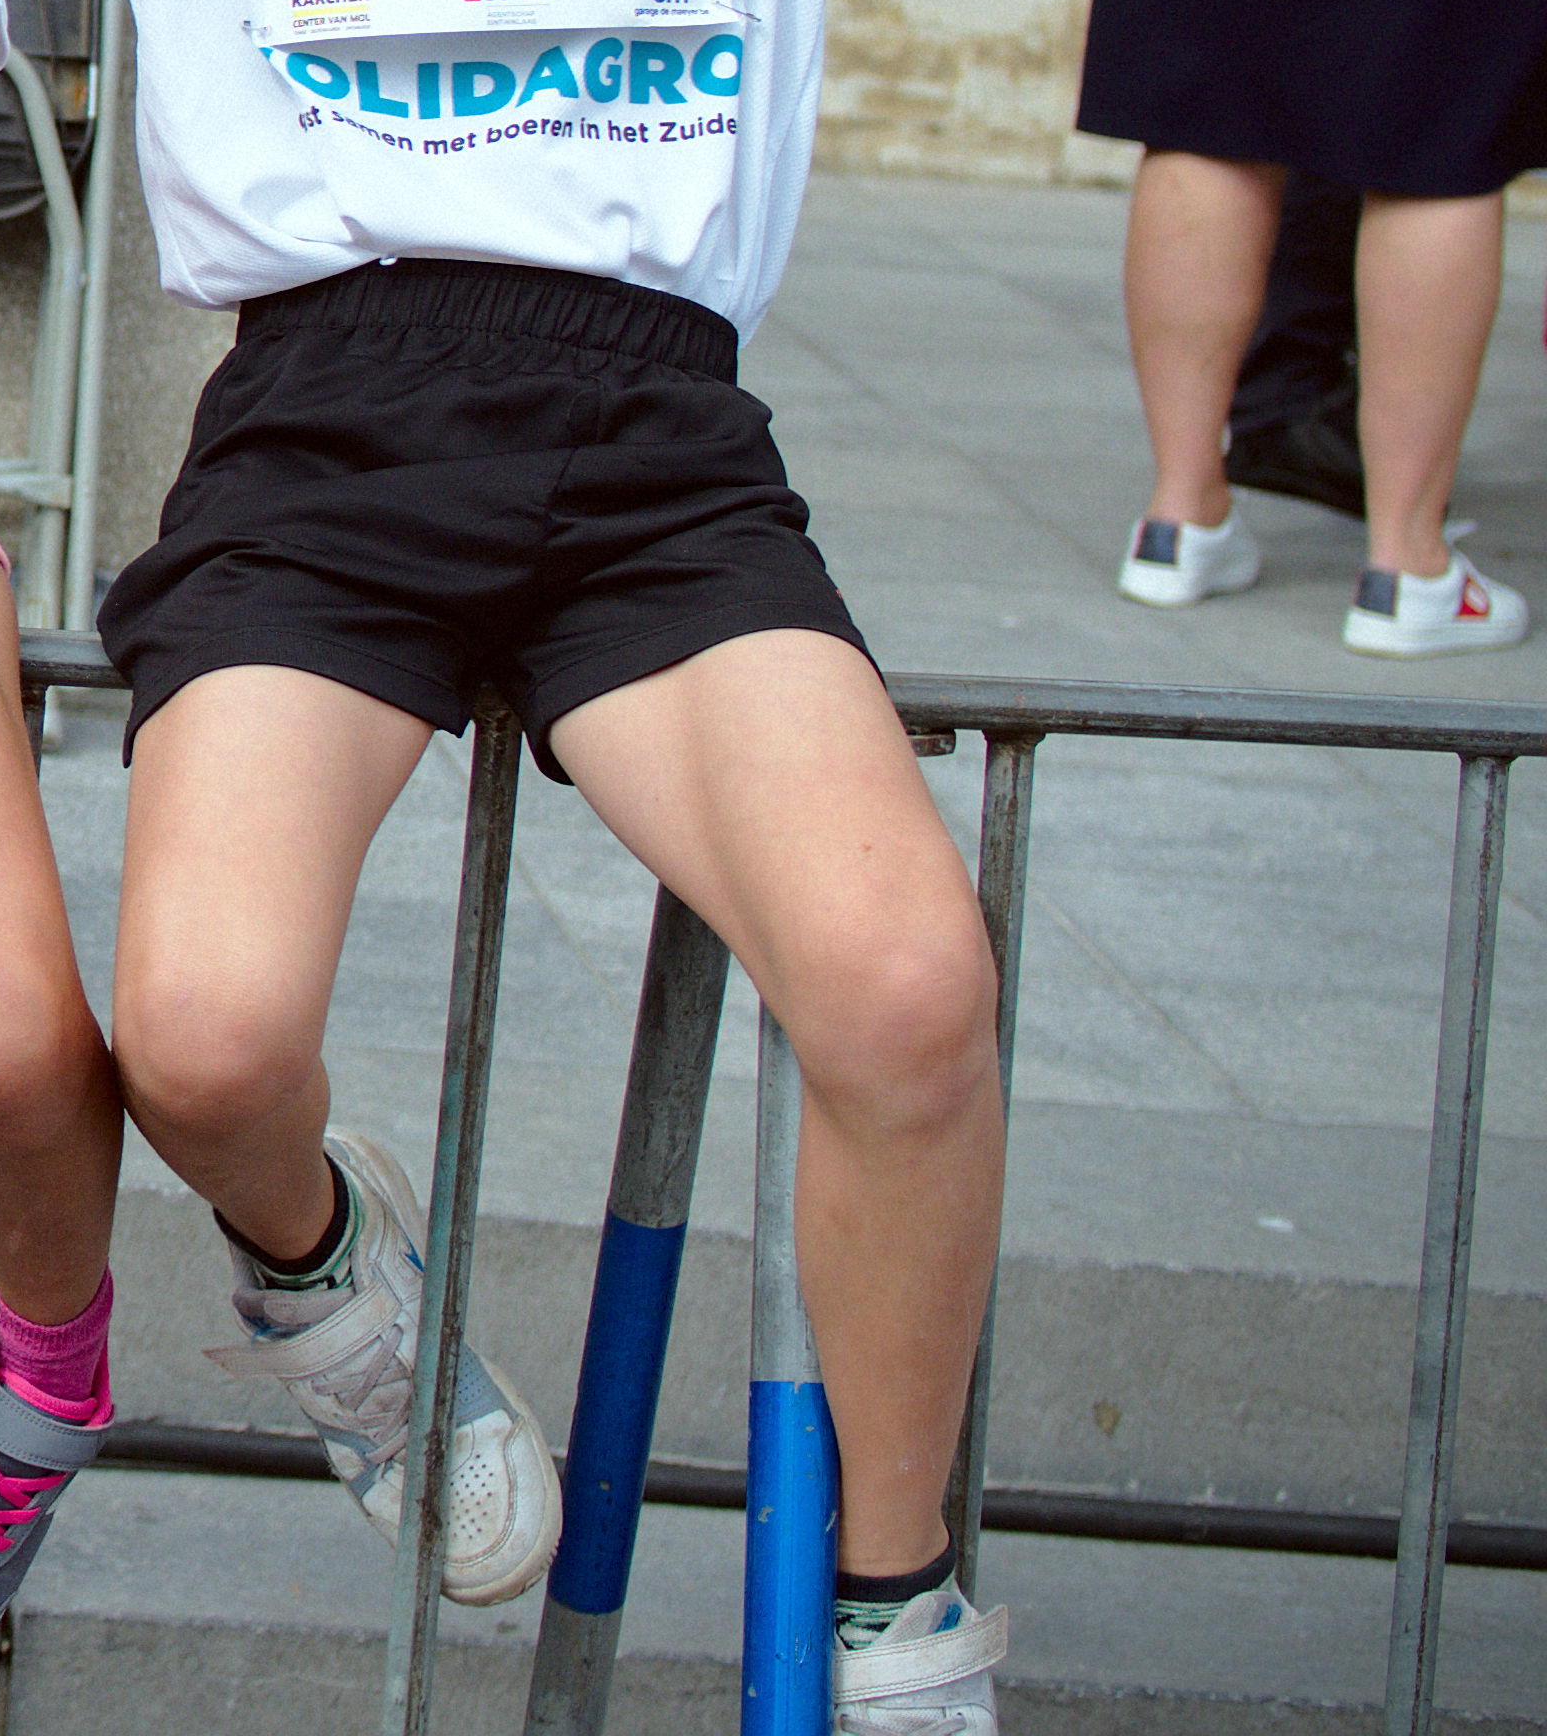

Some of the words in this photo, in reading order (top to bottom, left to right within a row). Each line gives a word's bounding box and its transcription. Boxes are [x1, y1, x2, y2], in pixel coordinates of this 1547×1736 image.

[328, 15, 347, 24] VAN
[258, 33, 743, 120] OLIDAGRO
[331, 110, 413, 152] samen
[423, 132, 477, 155] met
[486, 117, 573, 144] boeren
[579, 117, 600, 140] in
[607, 119, 649, 143] het
[659, 113, 737, 143] Zuide
